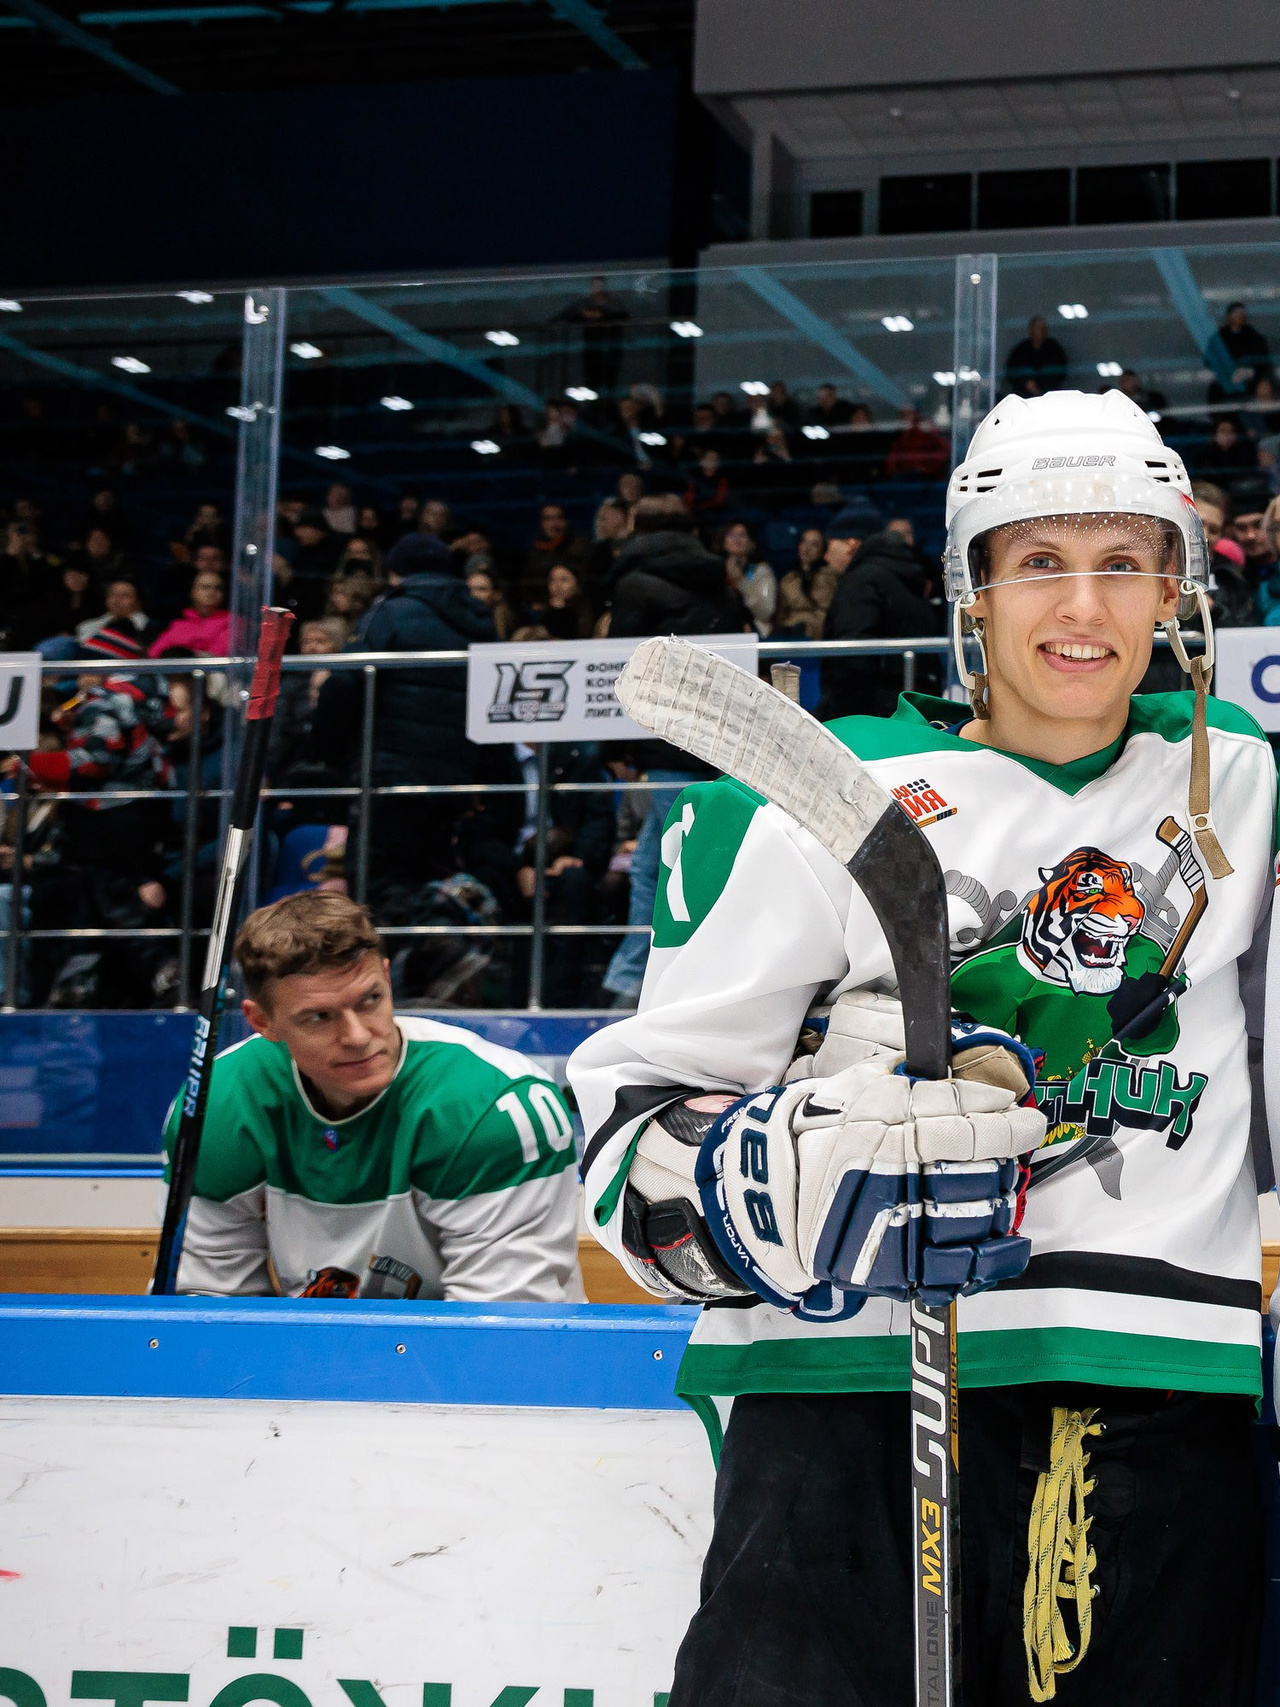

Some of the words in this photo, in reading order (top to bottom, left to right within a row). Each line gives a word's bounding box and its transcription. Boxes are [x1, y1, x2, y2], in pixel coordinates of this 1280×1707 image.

[1032, 455, 1116, 470] BAUER
[496, 1083, 573, 1163] 10
[740, 1086, 787, 1247] BAU
[722, 1214, 751, 1268] VAPOR
[921, 1497, 942, 1597] MX3
[926, 1600, 939, 1707] TALONE
